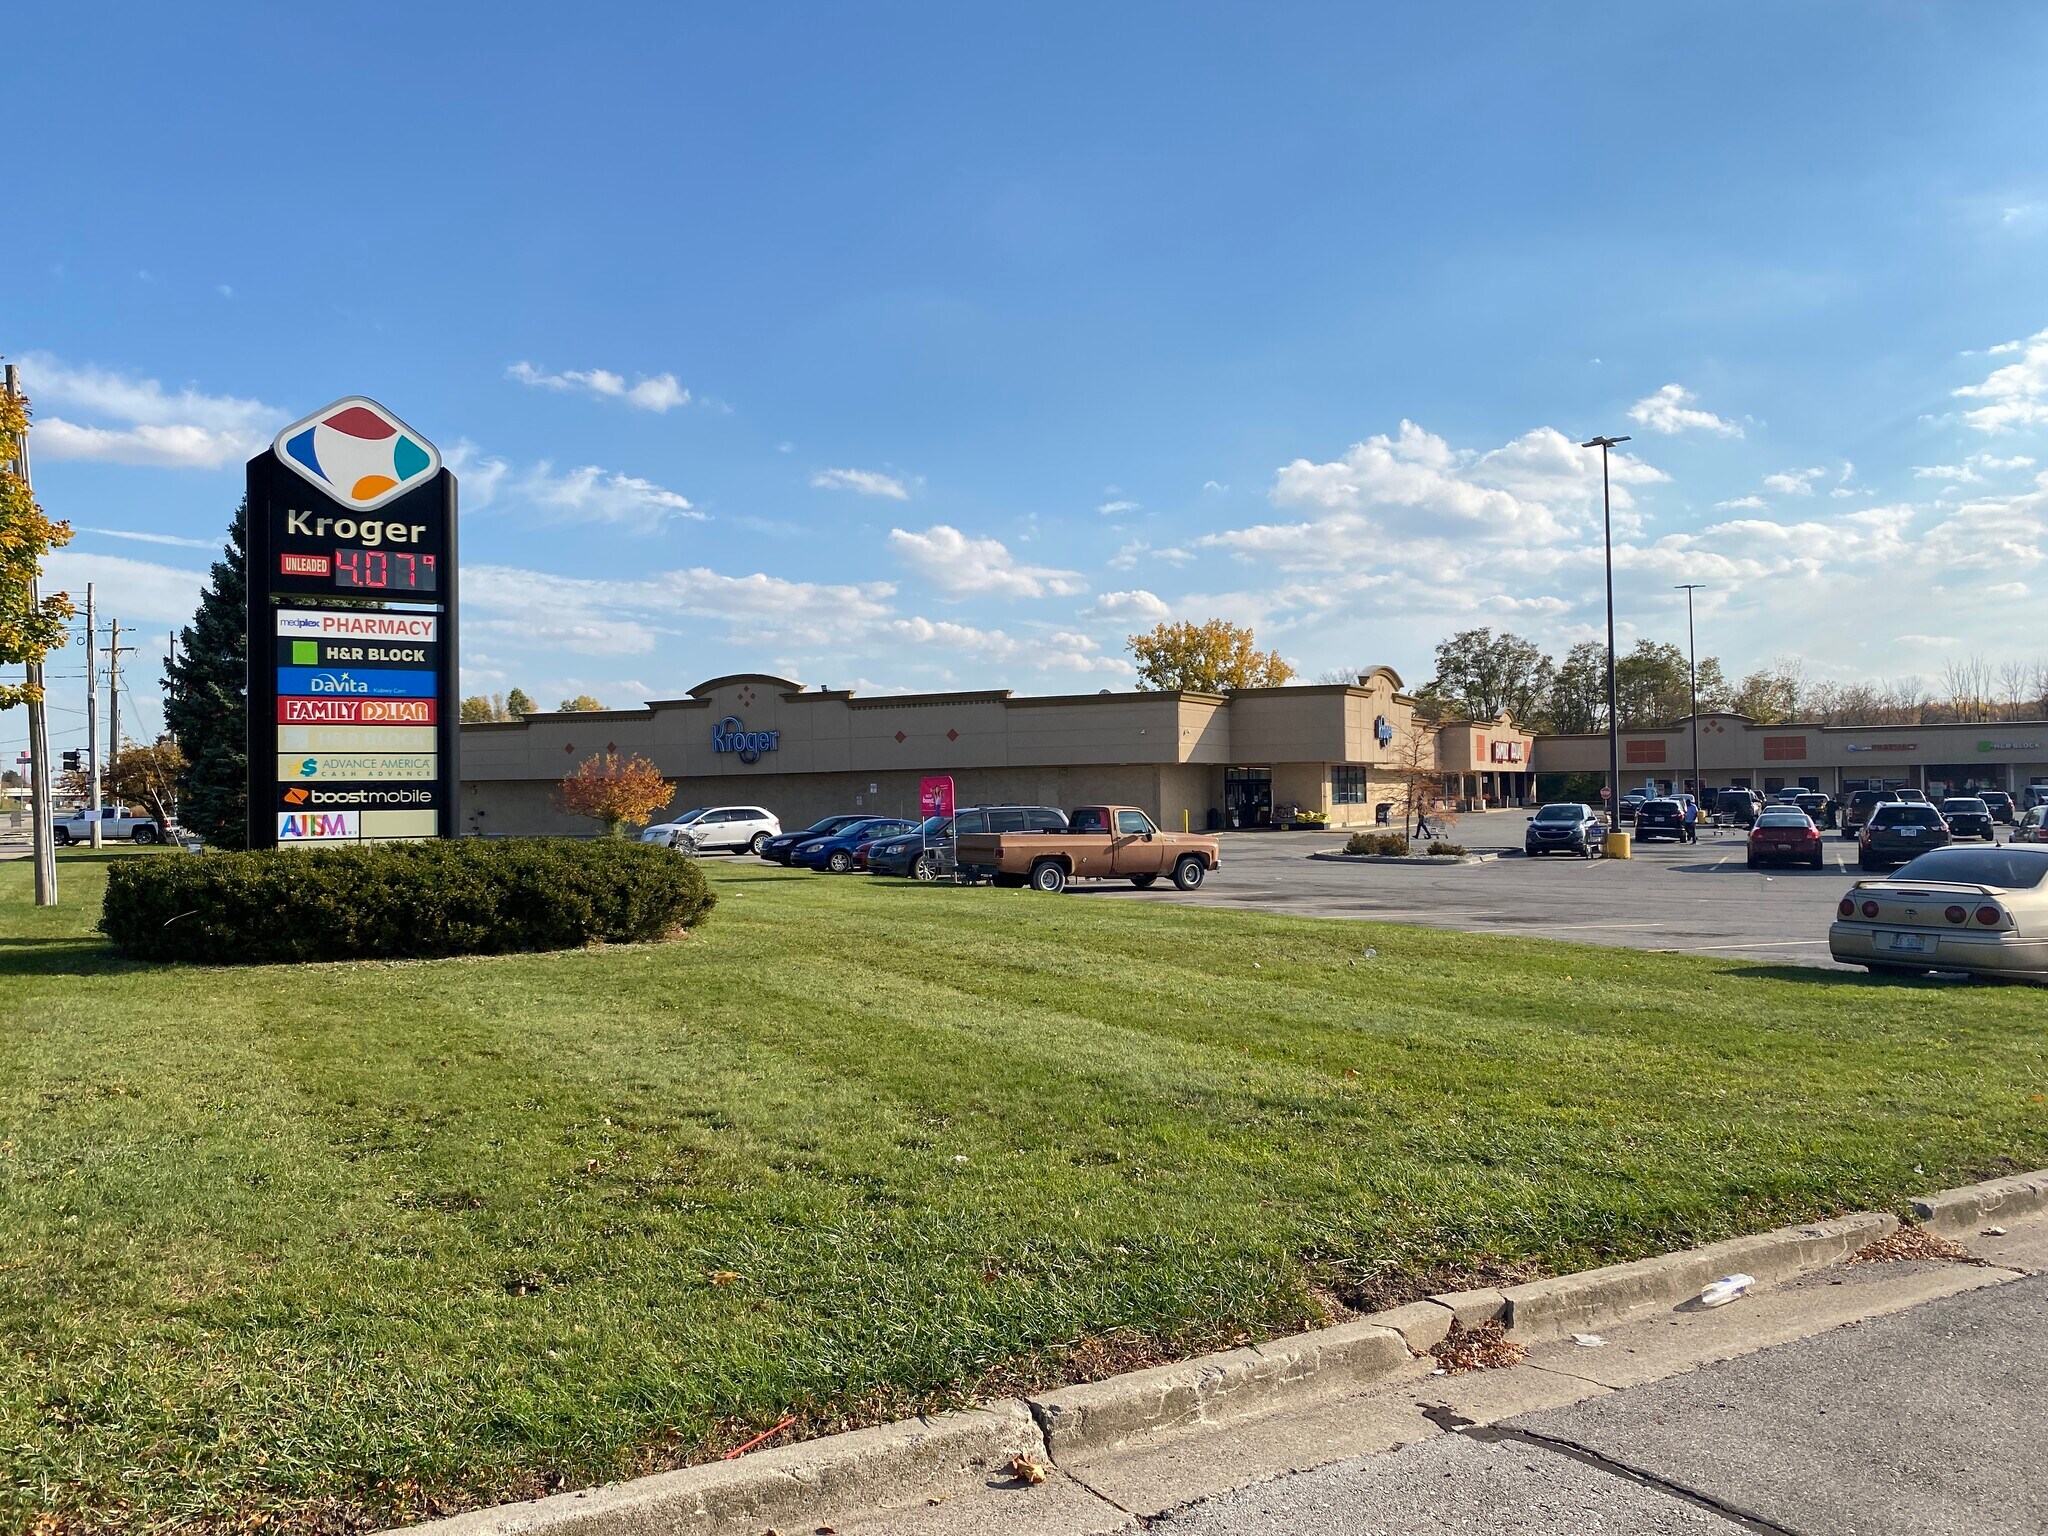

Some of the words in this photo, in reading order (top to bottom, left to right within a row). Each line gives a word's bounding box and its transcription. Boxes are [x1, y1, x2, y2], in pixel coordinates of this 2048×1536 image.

[287, 509, 427, 546] Kroger
[285, 557, 328, 573] UNLEADED
[280, 617, 320, 628] medplex
[323, 617, 433, 636] PHARMACY
[326, 647, 364, 661] H&R
[368, 648, 426, 662] BLOCK
[286, 700, 358, 721] FAMILY
[361, 701, 430, 721] DOLLAR
[711, 716, 779, 764] Kroger
[322, 759, 377, 769] ADVANCE
[380, 759, 430, 769] AMERICA
[280, 814, 347, 837] AUTISM
